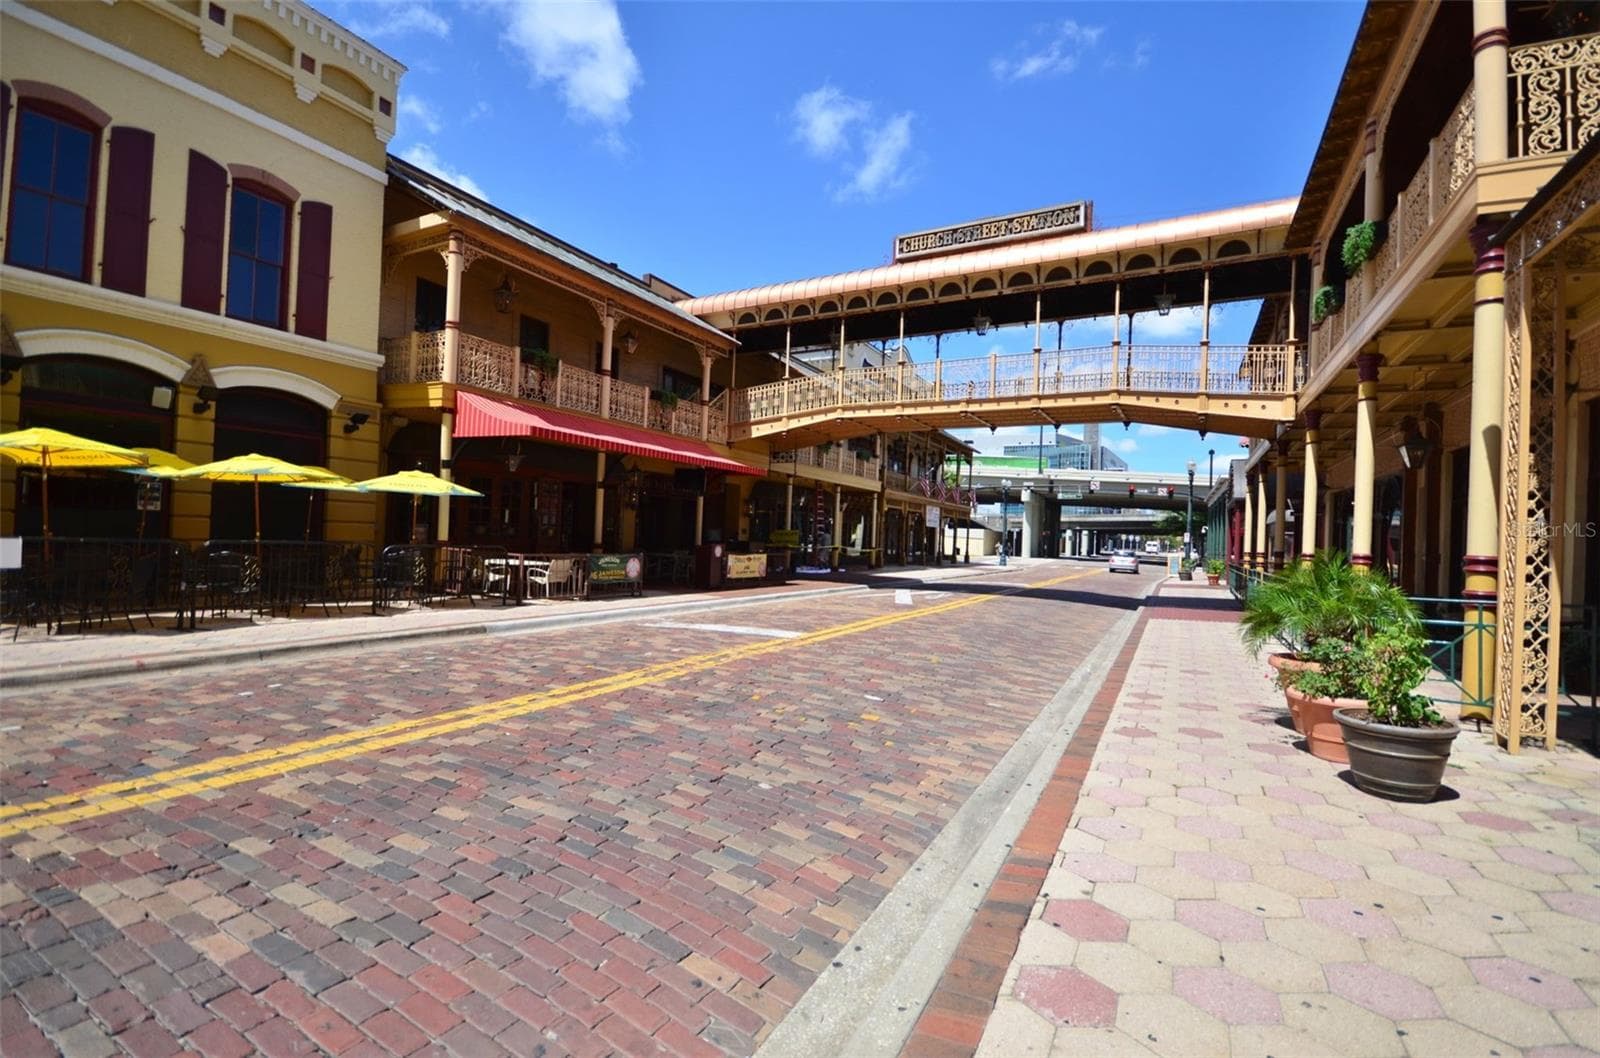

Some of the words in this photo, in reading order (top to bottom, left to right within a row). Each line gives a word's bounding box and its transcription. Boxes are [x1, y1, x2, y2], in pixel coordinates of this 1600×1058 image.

[903, 230, 953, 253] CHURCH
[958, 220, 1008, 243] STREET
[1013, 207, 1076, 234] STATION
